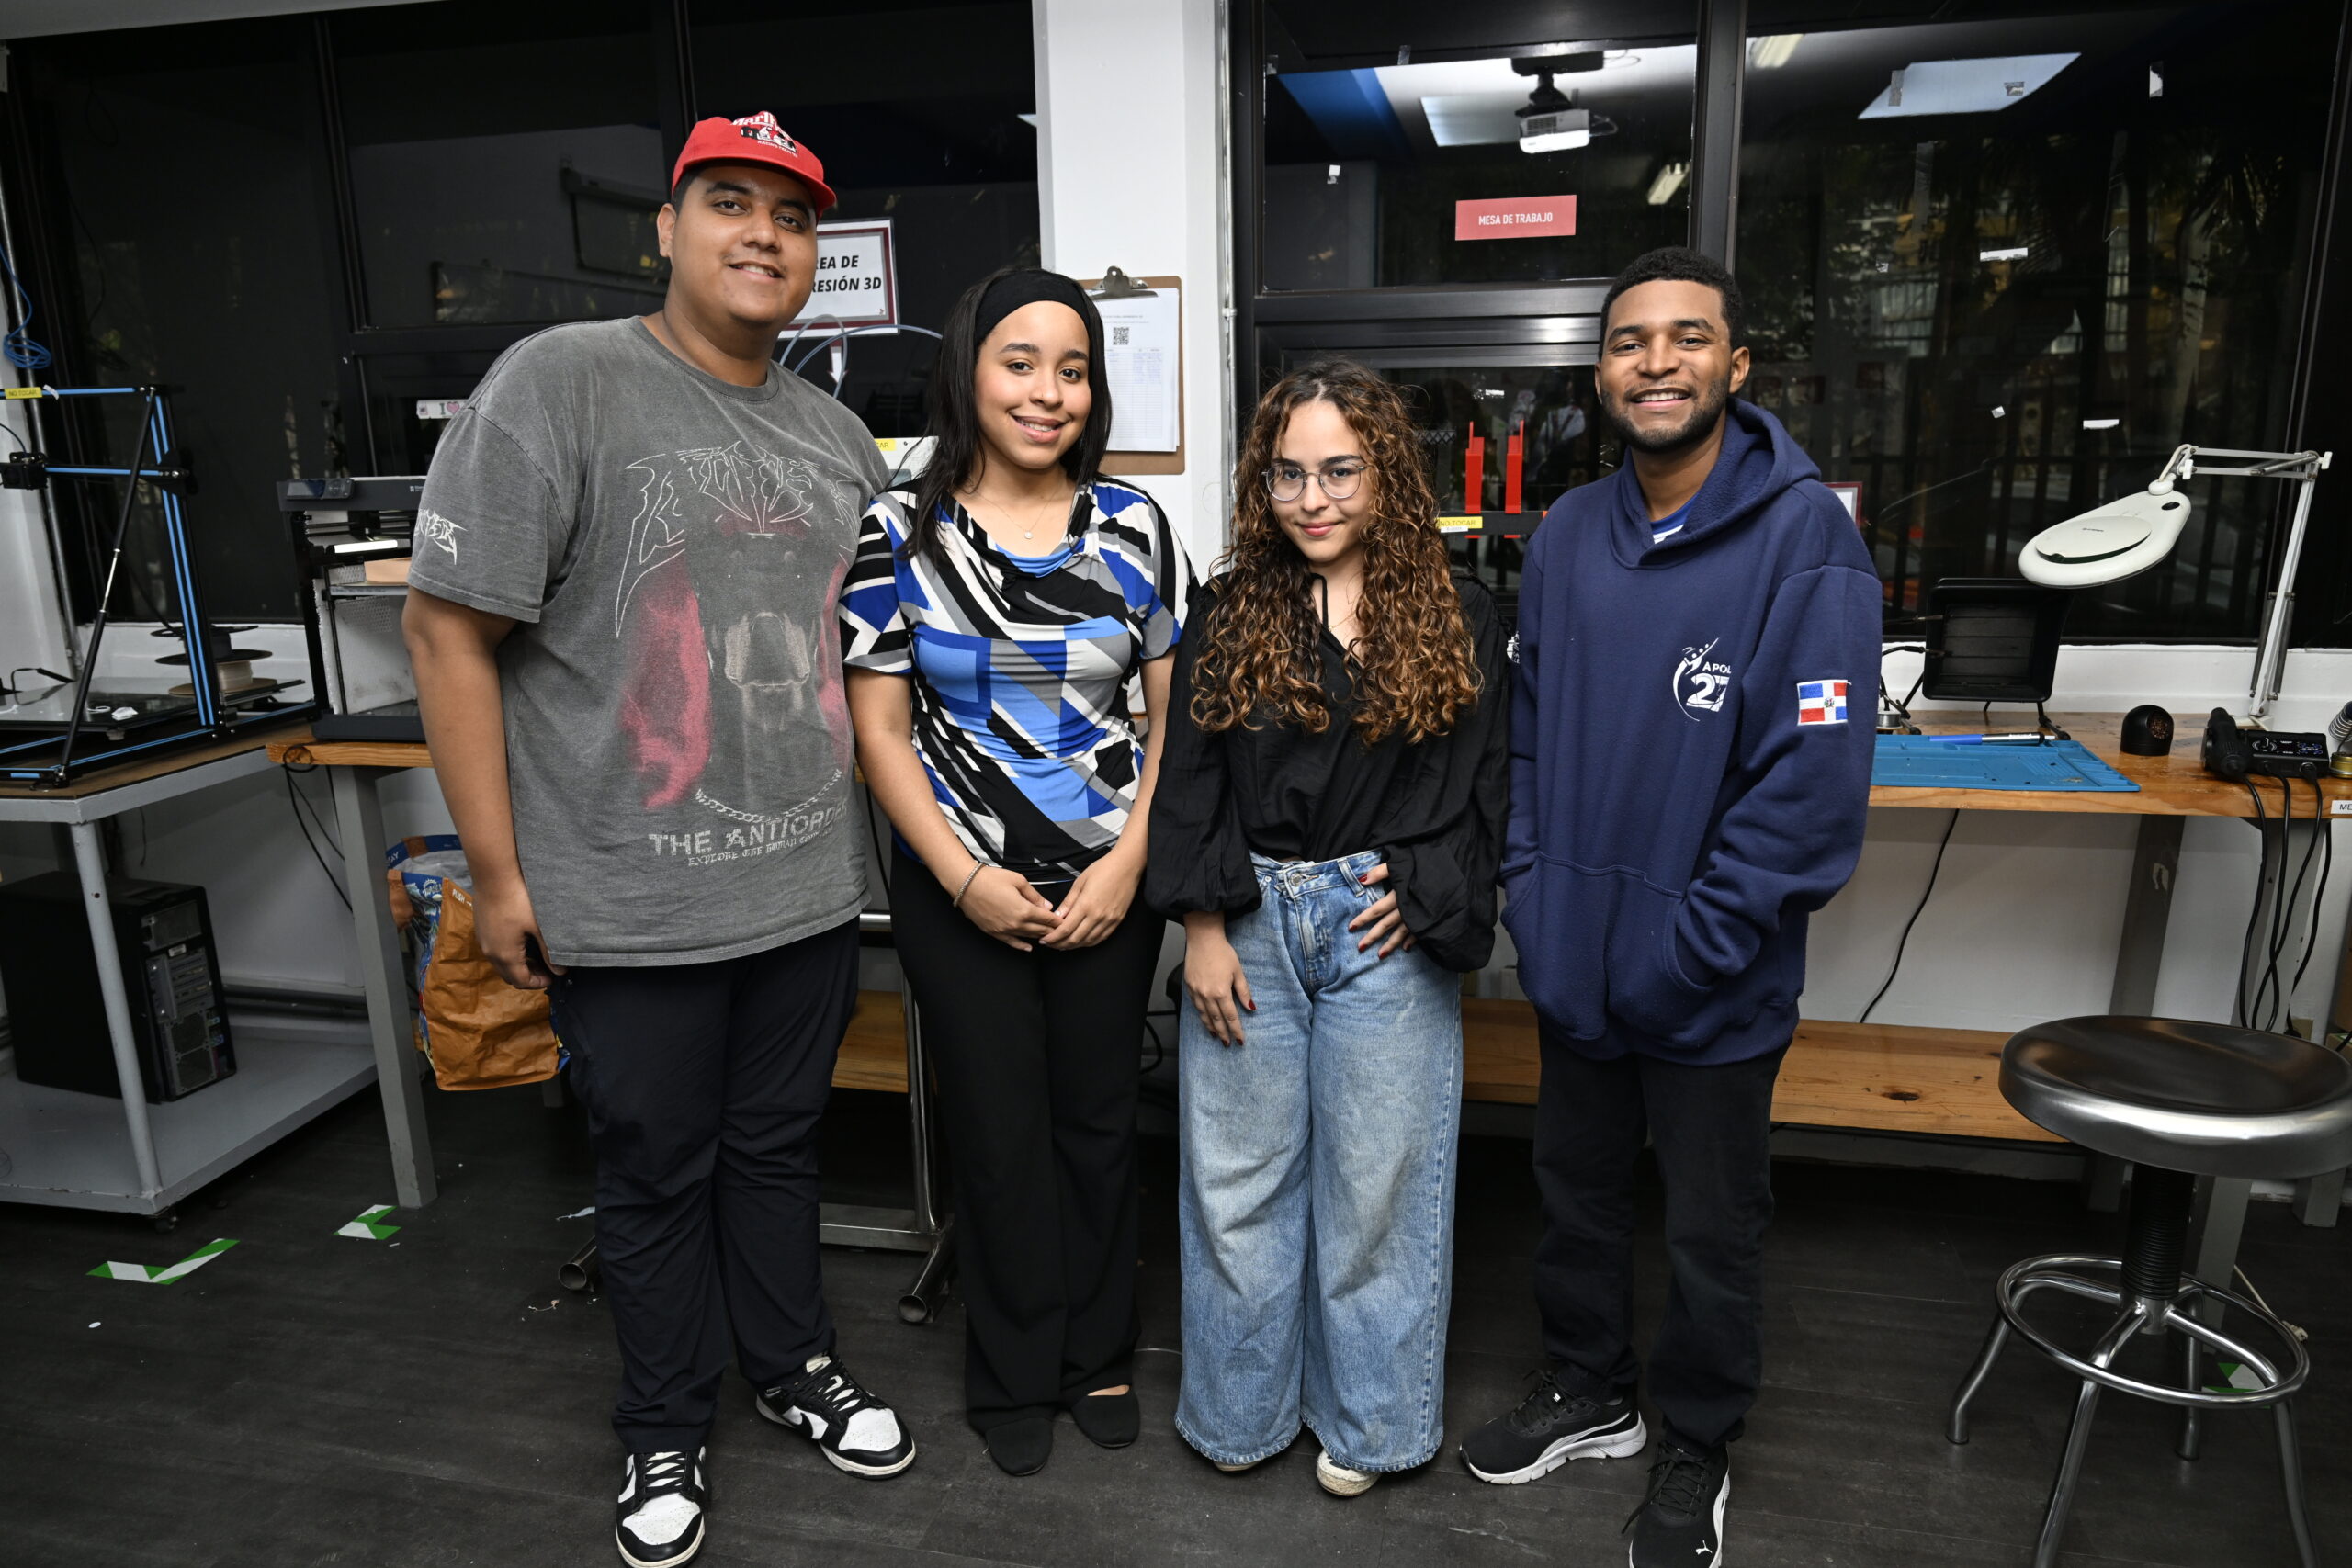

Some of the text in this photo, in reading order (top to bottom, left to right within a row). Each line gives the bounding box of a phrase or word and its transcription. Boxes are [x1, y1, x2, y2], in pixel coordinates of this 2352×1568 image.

[1478, 212, 1554, 226] MESA DE TRABAJO
[816, 255, 859, 270] EA DE
[812, 275, 882, 293] ESIÓN 3D
[1702, 661, 1732, 674] APOL
[1686, 672, 1730, 713] 27
[648, 829, 712, 856] THE
[452, 888, 466, 904] PUSH
